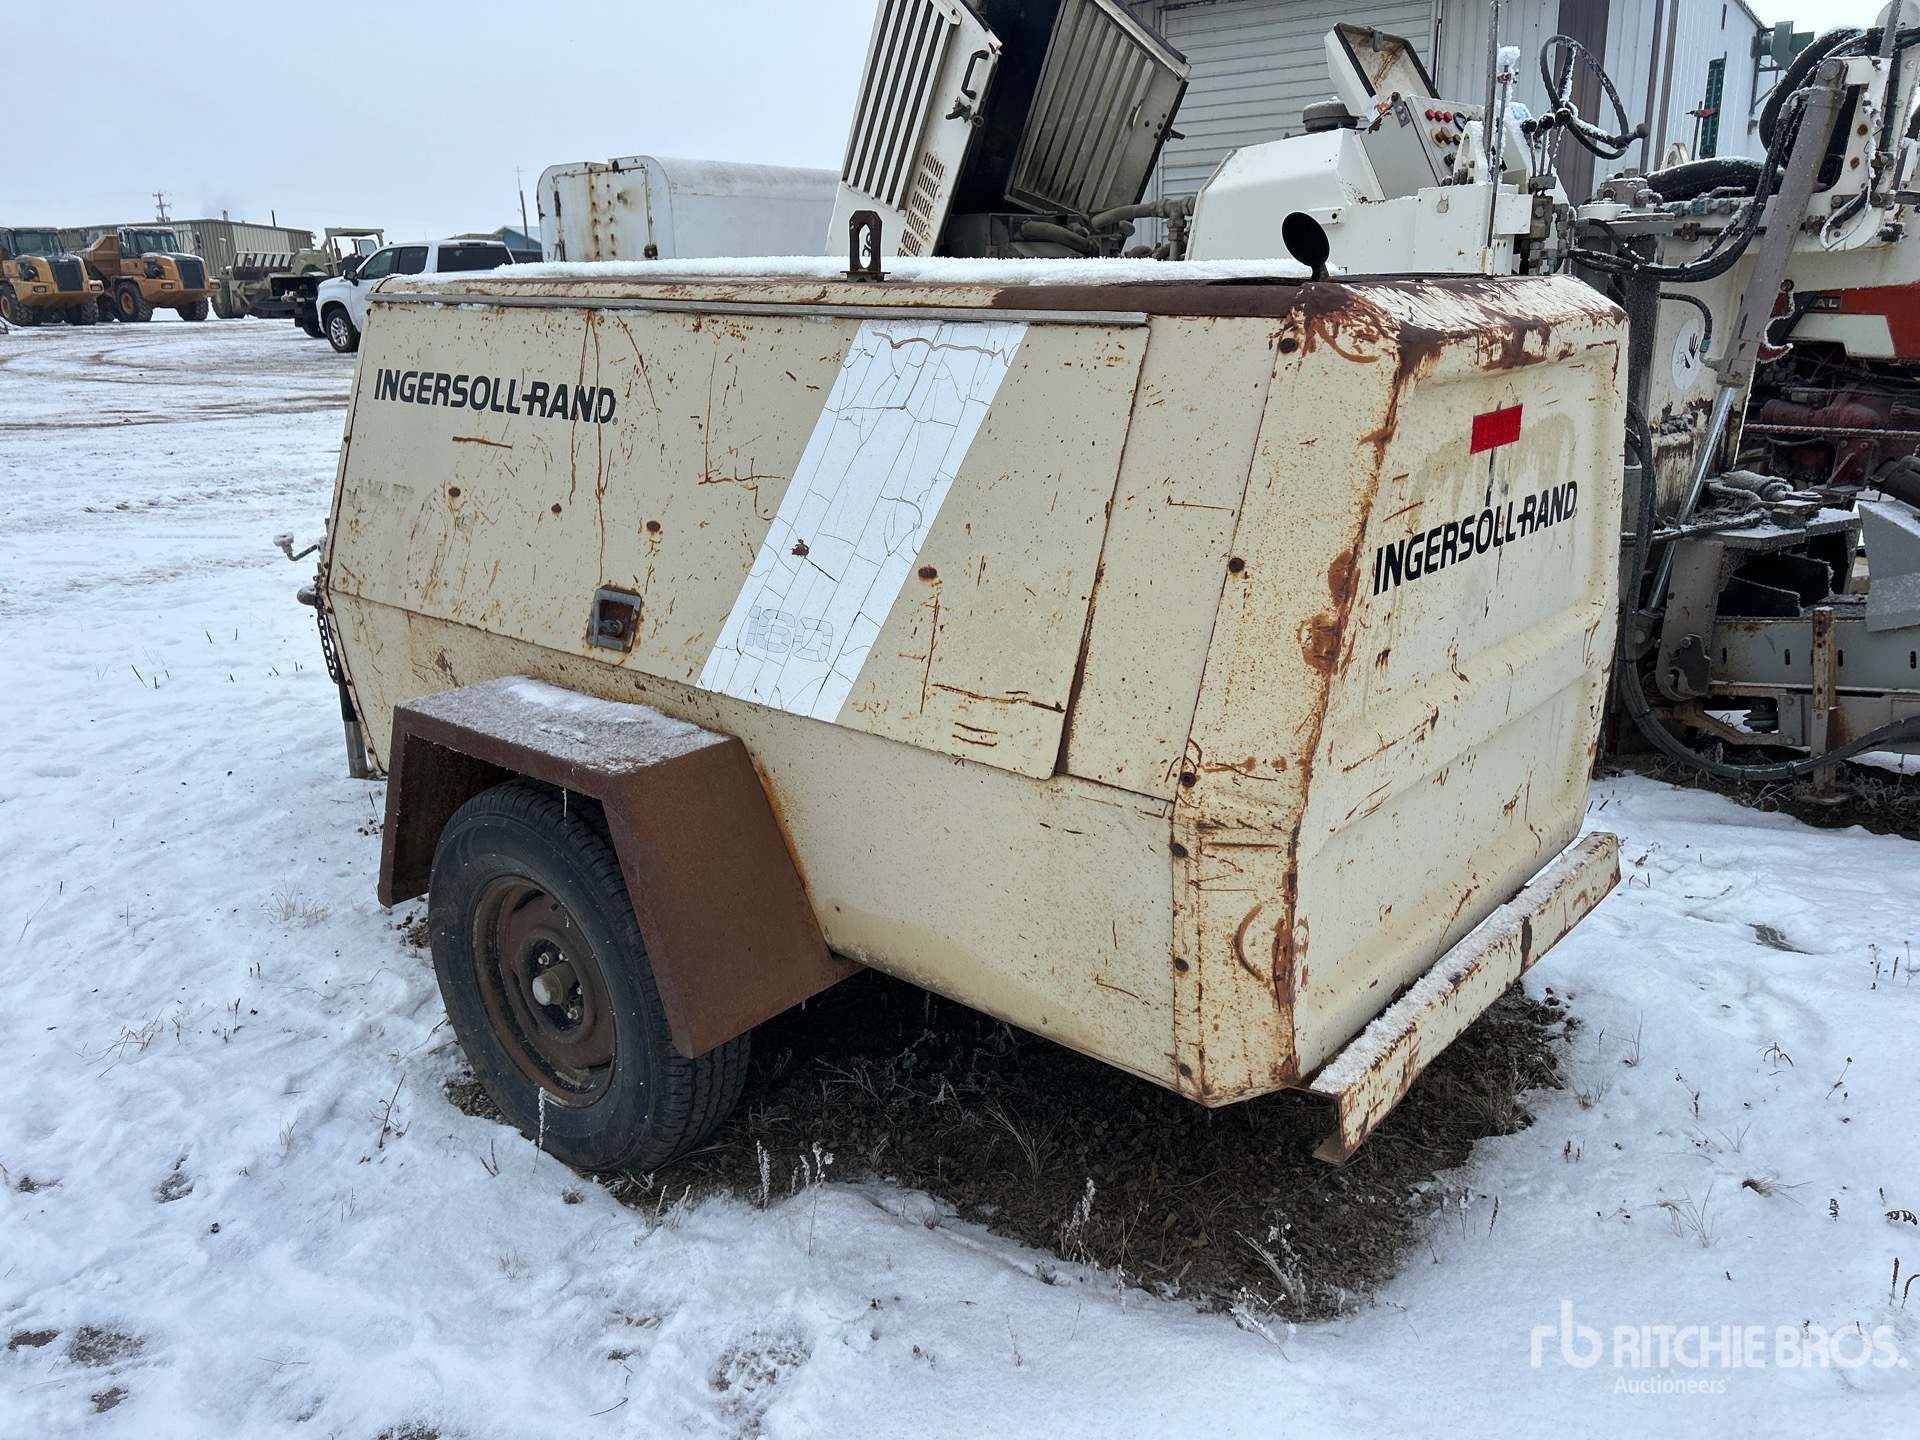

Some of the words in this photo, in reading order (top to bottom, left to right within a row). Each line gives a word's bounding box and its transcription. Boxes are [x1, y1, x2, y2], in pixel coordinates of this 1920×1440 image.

[1809, 297, 1838, 309] AL
[374, 368, 617, 424] INGERSOLL-RAND
[1373, 480, 1578, 596] INGERSOLL-RAND
